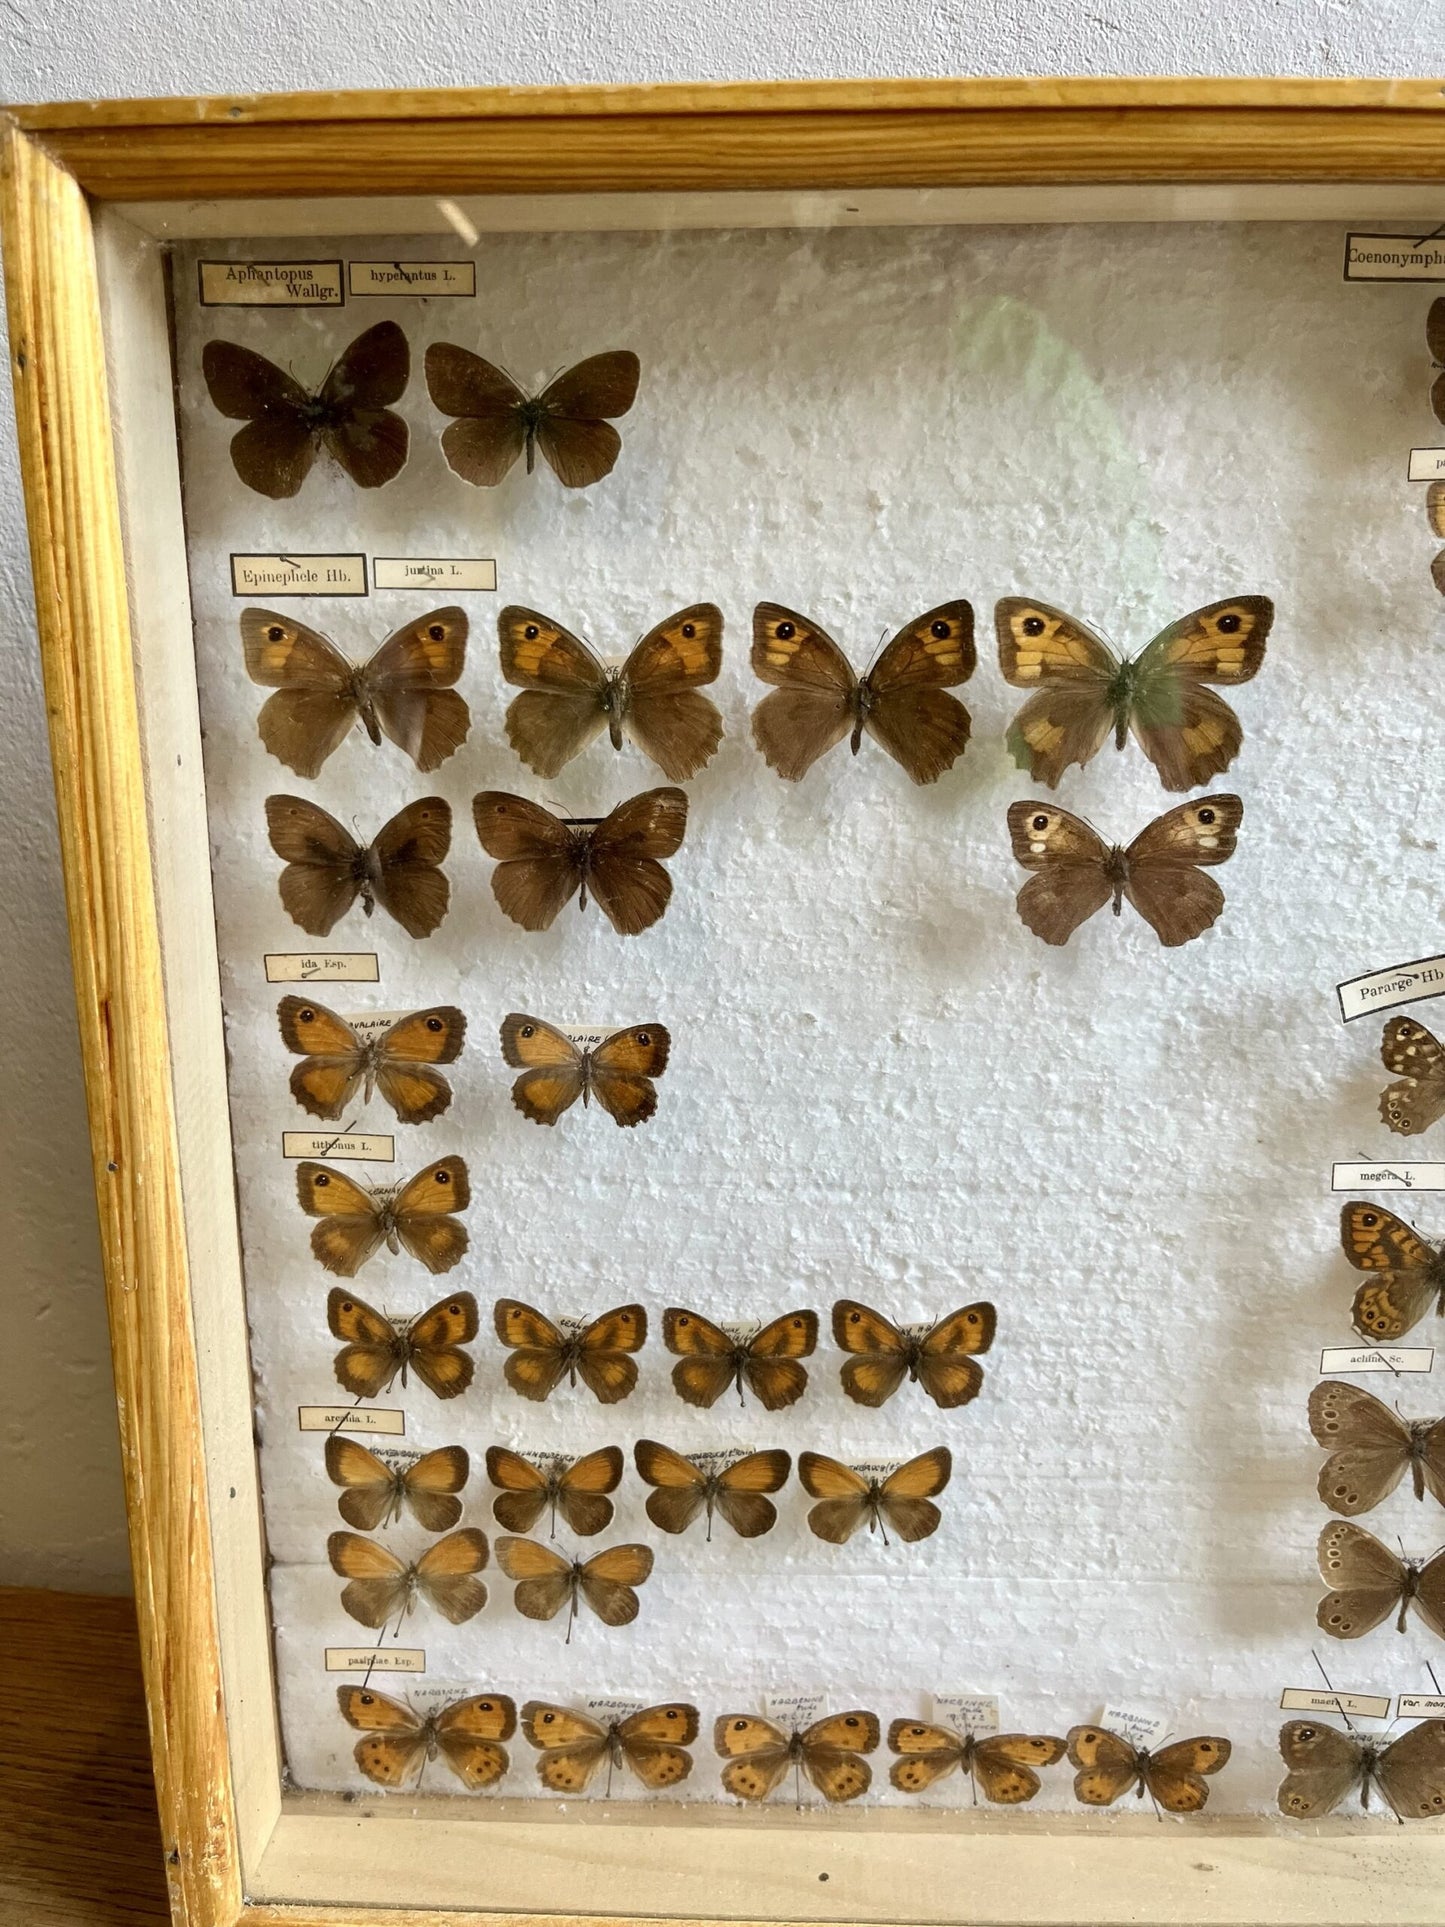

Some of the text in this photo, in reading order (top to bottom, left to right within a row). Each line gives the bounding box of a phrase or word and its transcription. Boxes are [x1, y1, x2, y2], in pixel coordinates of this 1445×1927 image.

[1348, 248, 1445, 268] Coenonymph
[443, 270, 456, 281] L.
[286, 283, 339, 300] Wallgr.
[450, 565, 463, 576] L.
[243, 569, 351, 586] Epinephele Hb.
[301, 960, 347, 970] ida Esp.
[1360, 978, 1413, 1000] Pararge
[361, 1142, 372, 1151] L.
[1405, 1171, 1416, 1181] L.
